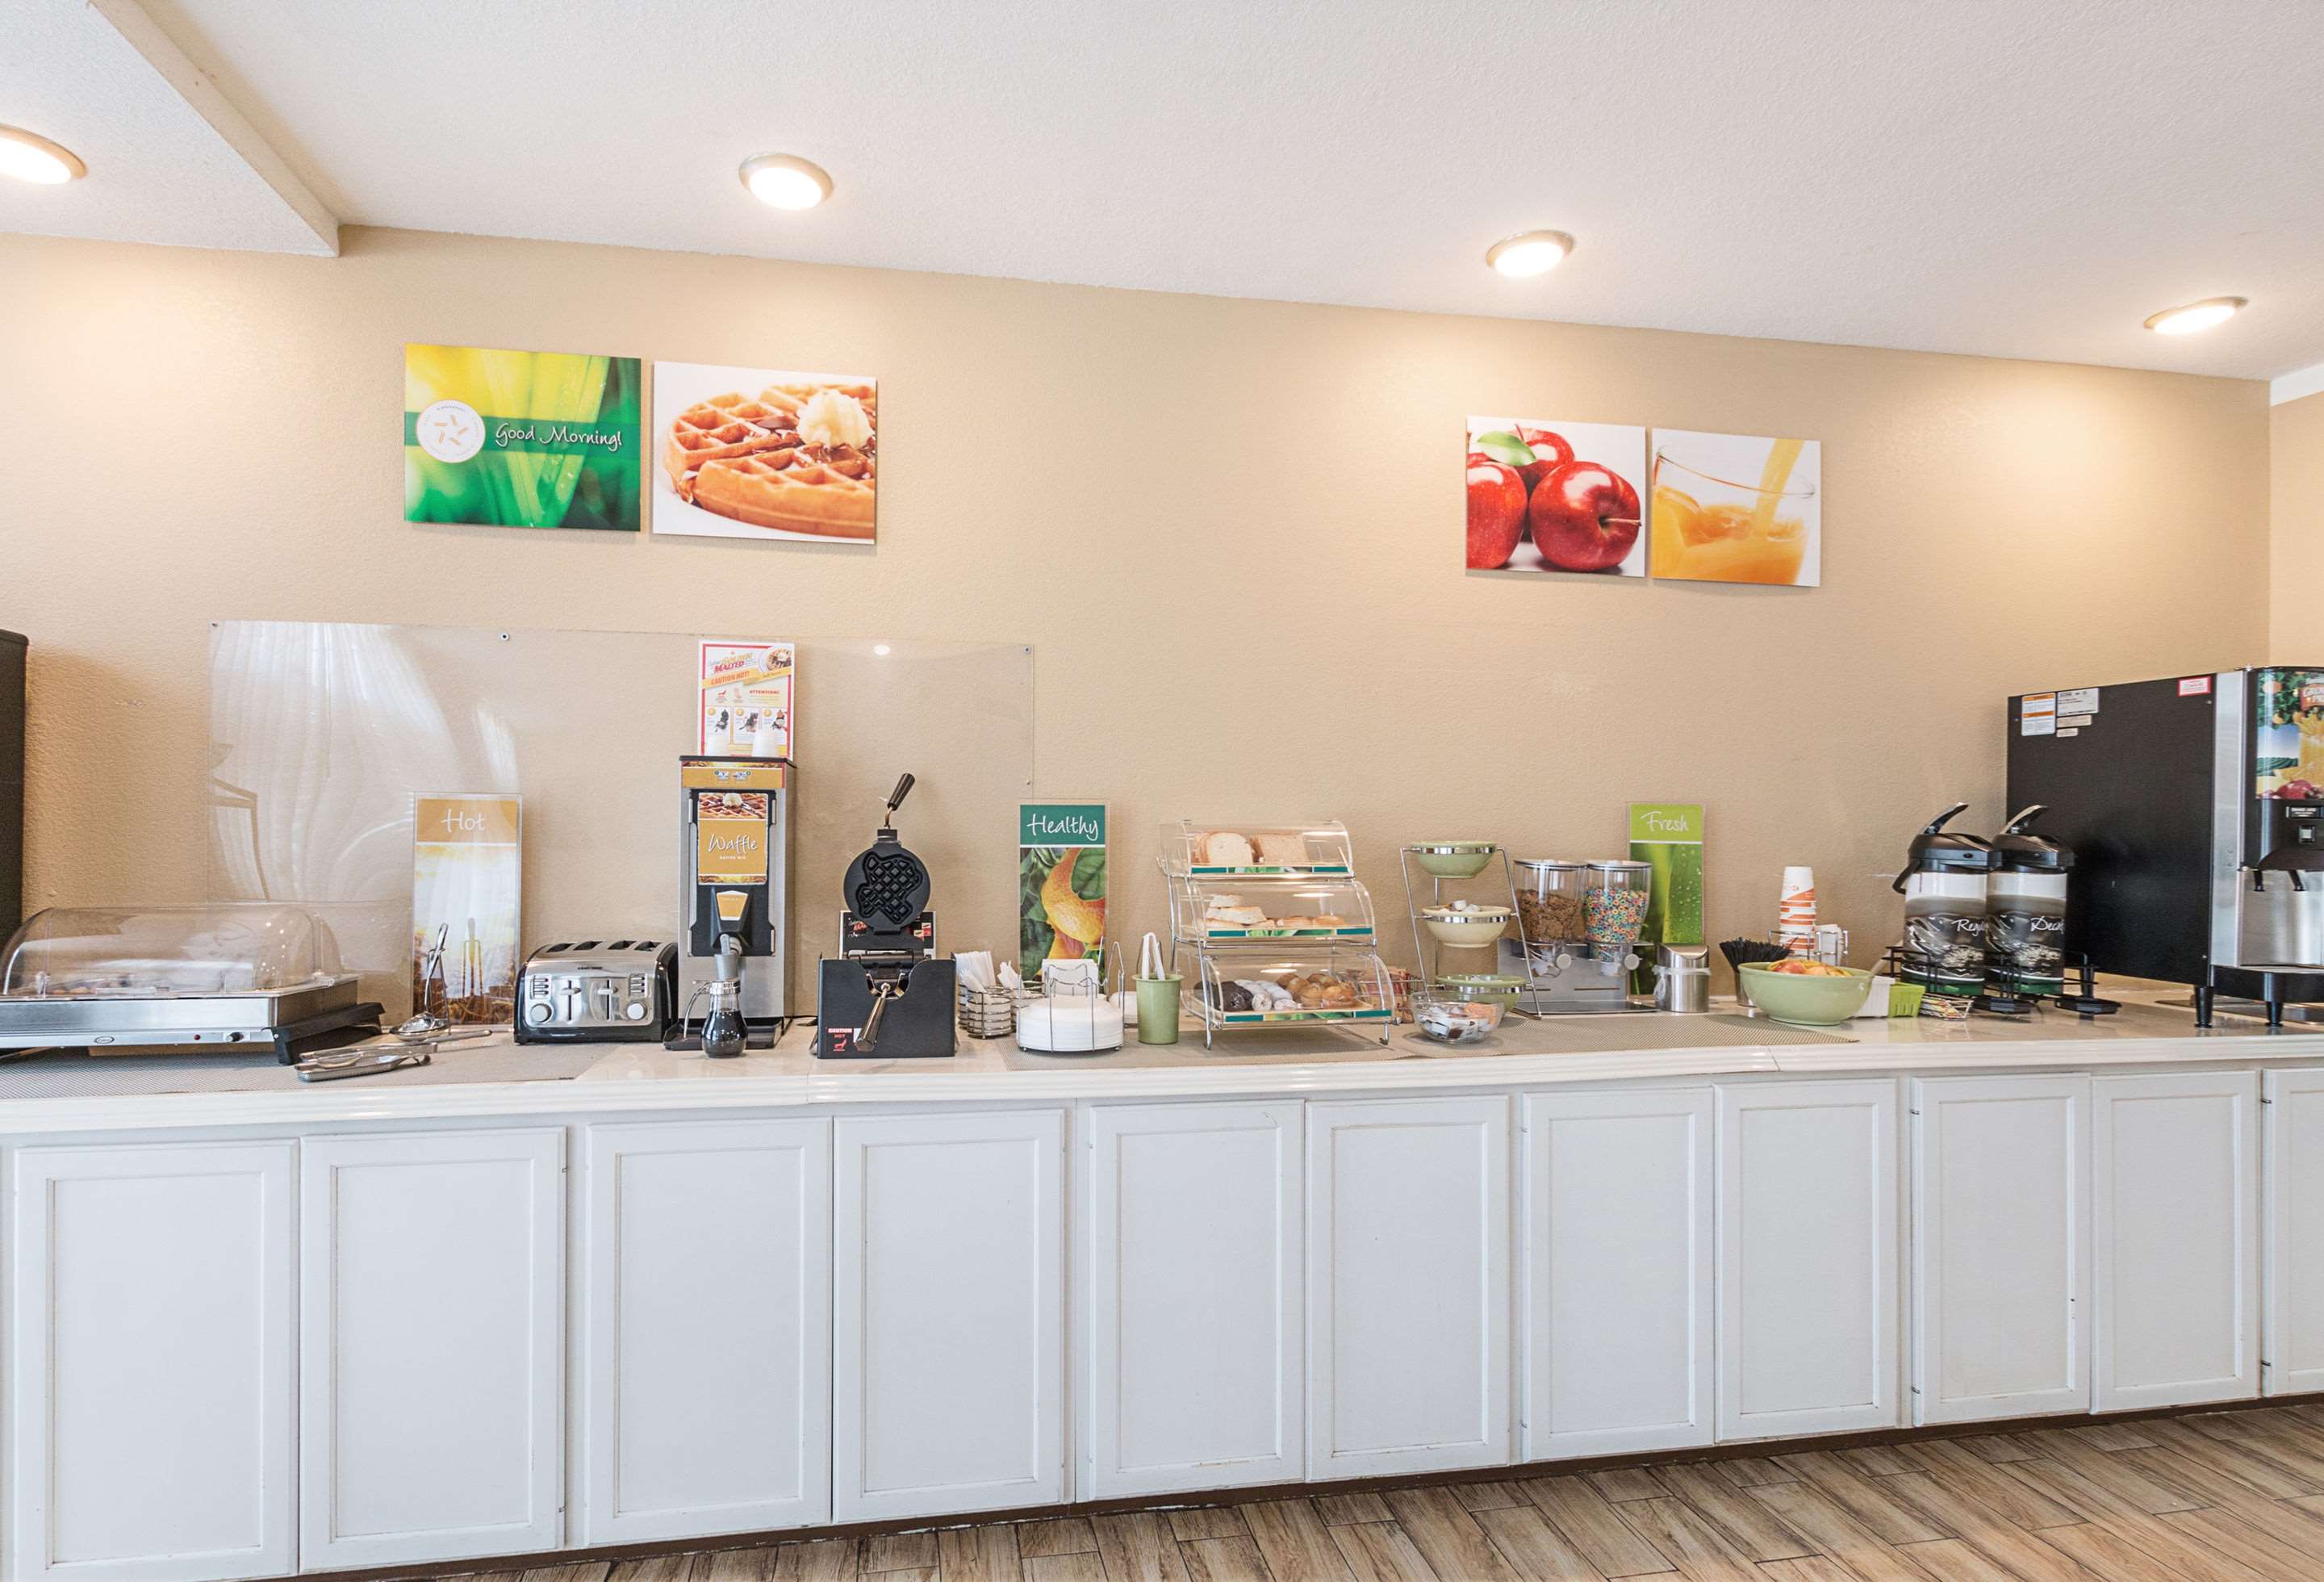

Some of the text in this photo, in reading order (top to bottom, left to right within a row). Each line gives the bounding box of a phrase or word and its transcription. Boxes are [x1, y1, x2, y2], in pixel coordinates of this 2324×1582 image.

[495, 422, 623, 452] Good Morning!
[710, 673, 736, 685] CAUTION
[440, 808, 487, 834] Hot
[1026, 813, 1099, 841] Healthy
[1641, 810, 1689, 832] Fresh
[708, 832, 758, 854] Waffle
